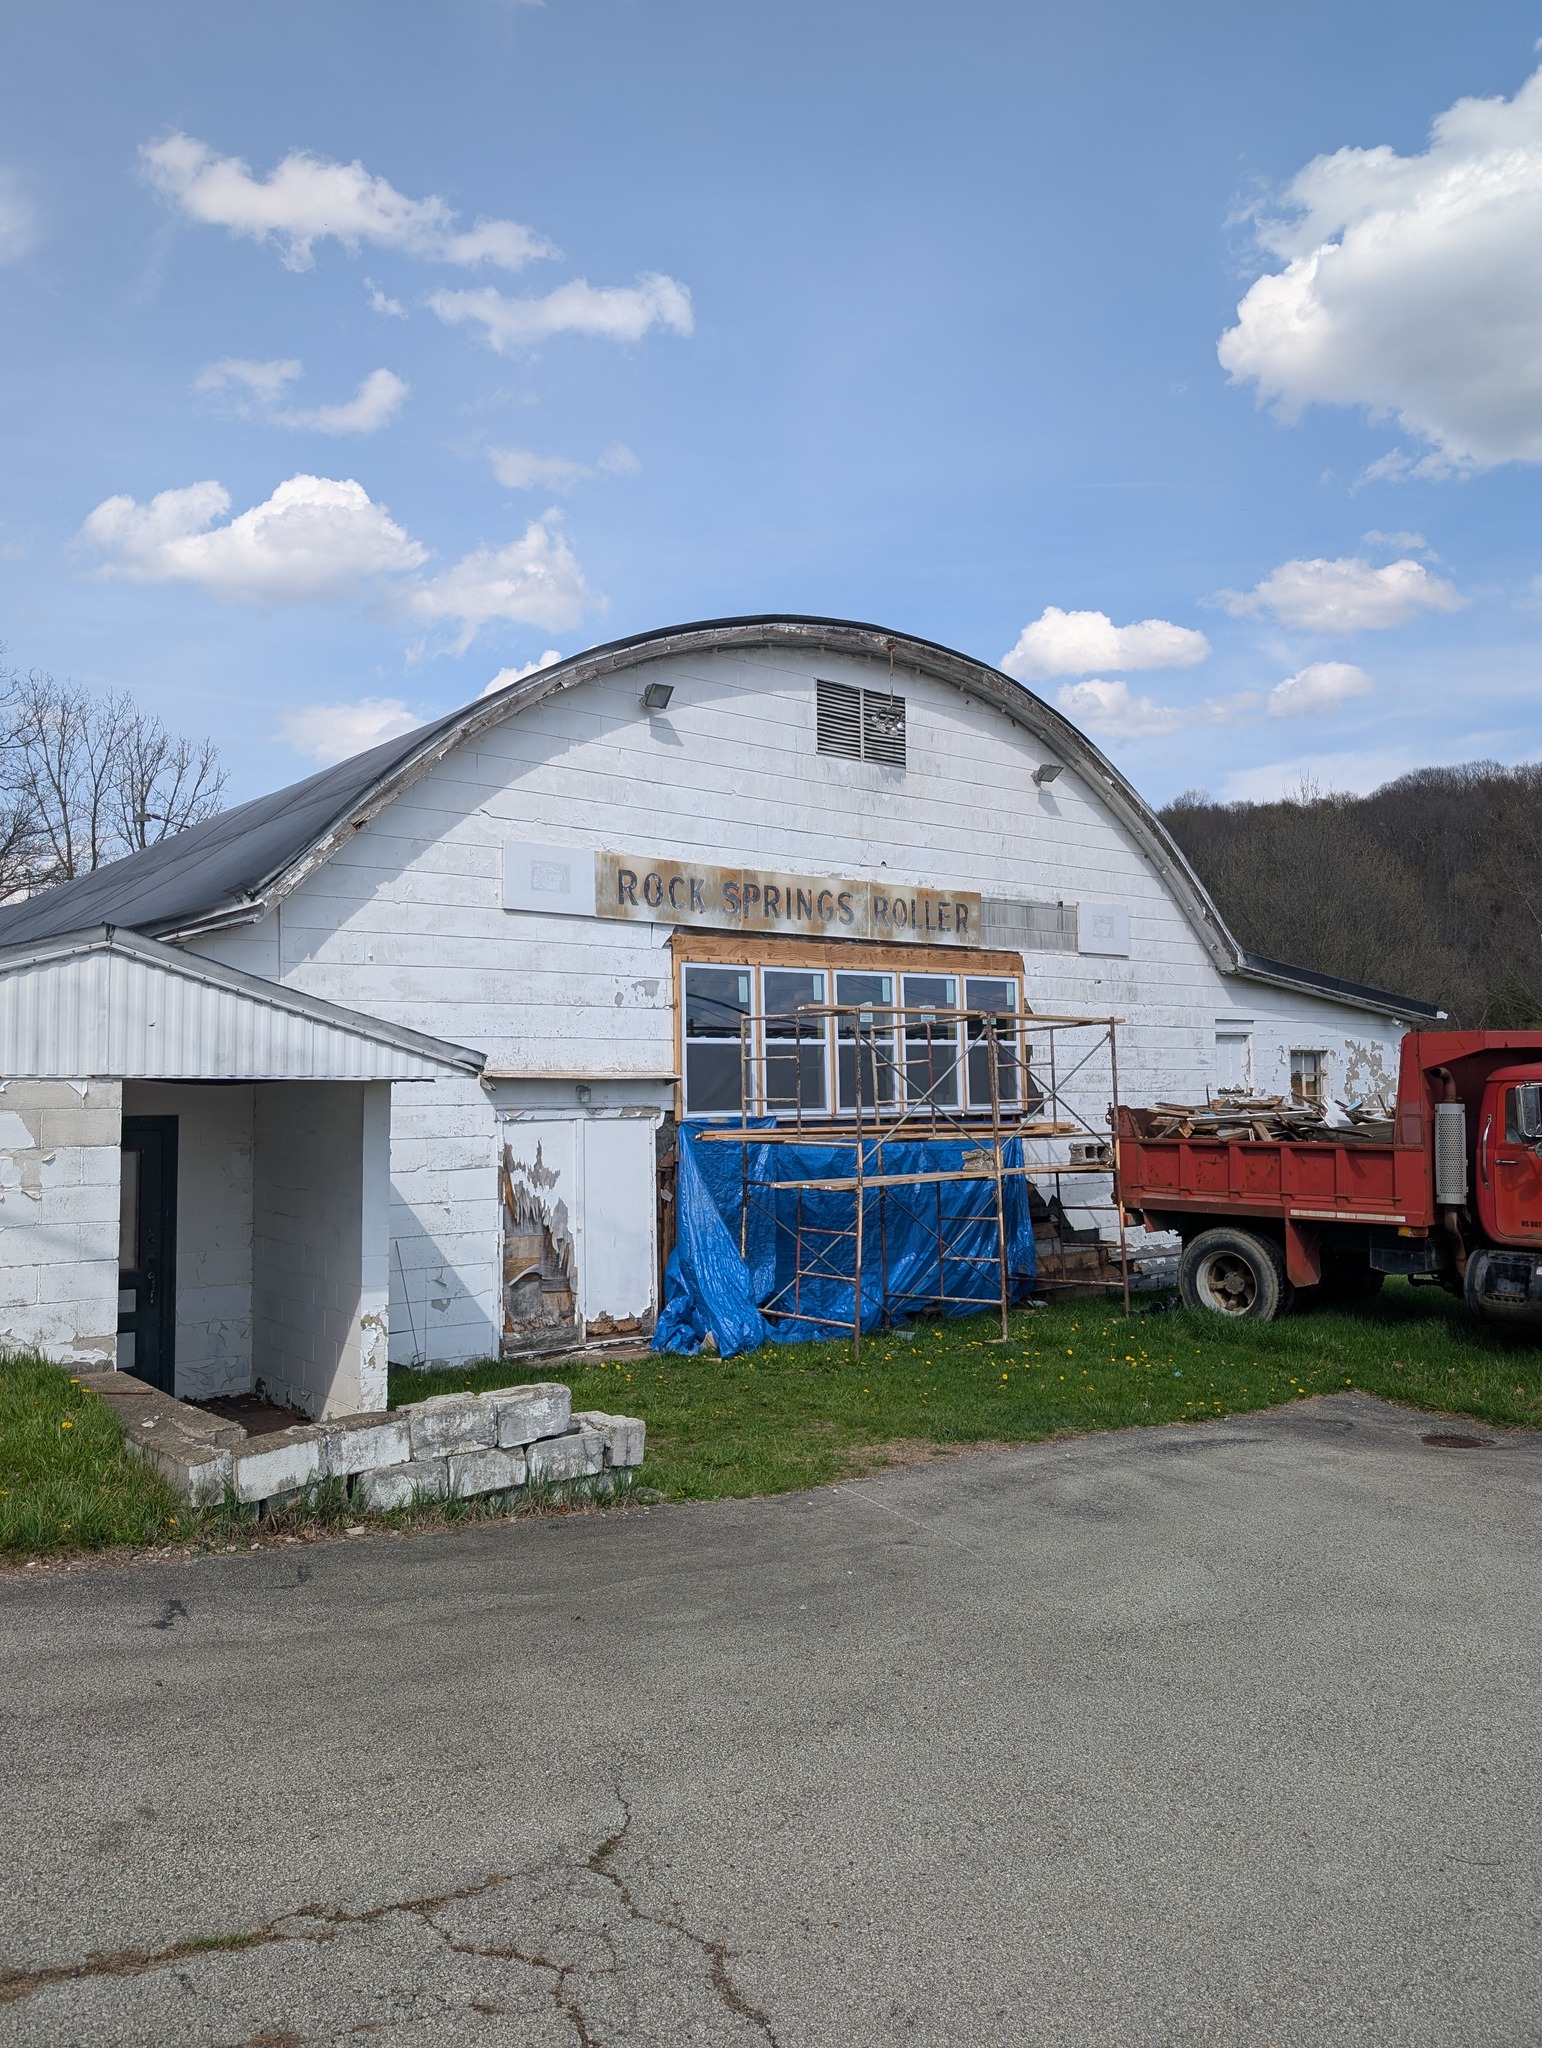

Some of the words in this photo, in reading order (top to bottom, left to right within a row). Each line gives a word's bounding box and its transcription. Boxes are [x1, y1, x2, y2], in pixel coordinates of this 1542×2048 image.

[617, 868, 708, 913] ROCK
[721, 880, 855, 927] SPRINGS
[873, 895, 969, 934] ROLLER
[1521, 1220, 1530, 1228] US
